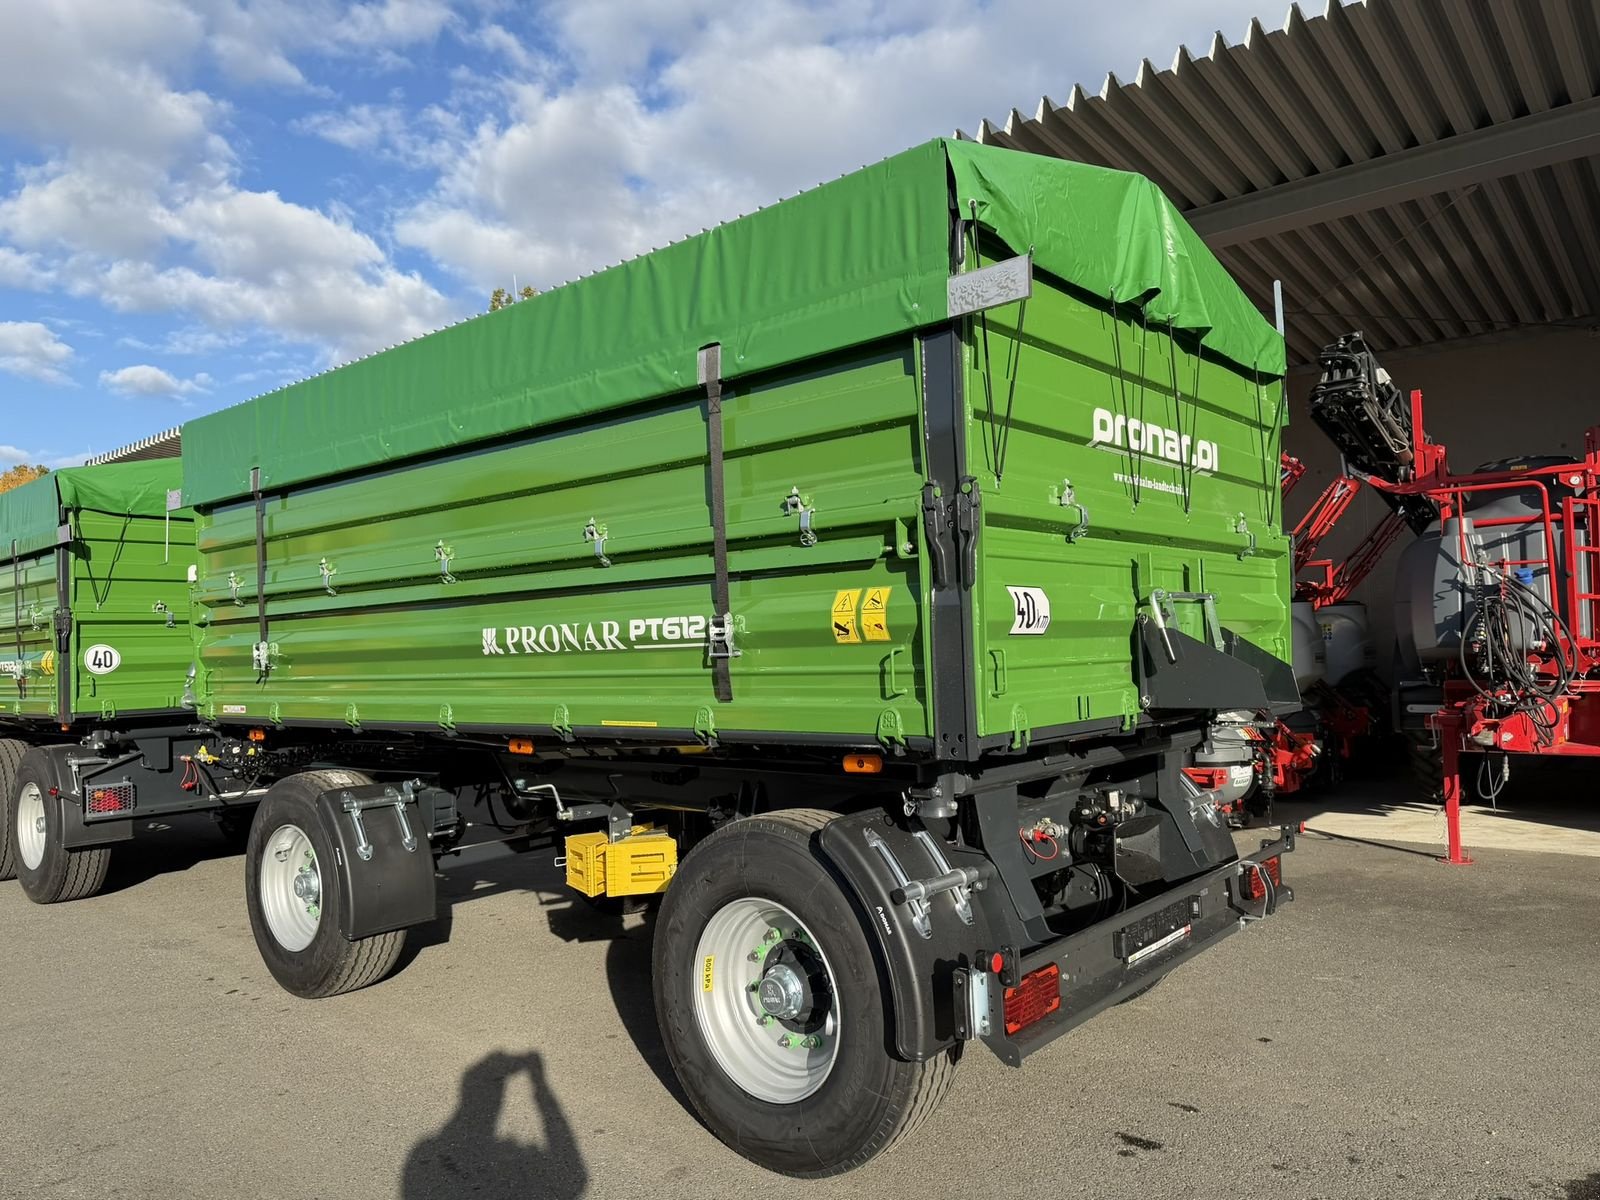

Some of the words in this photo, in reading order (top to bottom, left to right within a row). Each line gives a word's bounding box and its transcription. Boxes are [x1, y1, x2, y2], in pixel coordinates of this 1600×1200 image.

[1090, 407, 1218, 473] pronar.pl
[1014, 591, 1036, 629] 40
[505, 620, 628, 655] PRONAR
[92, 650, 113, 670] 40
